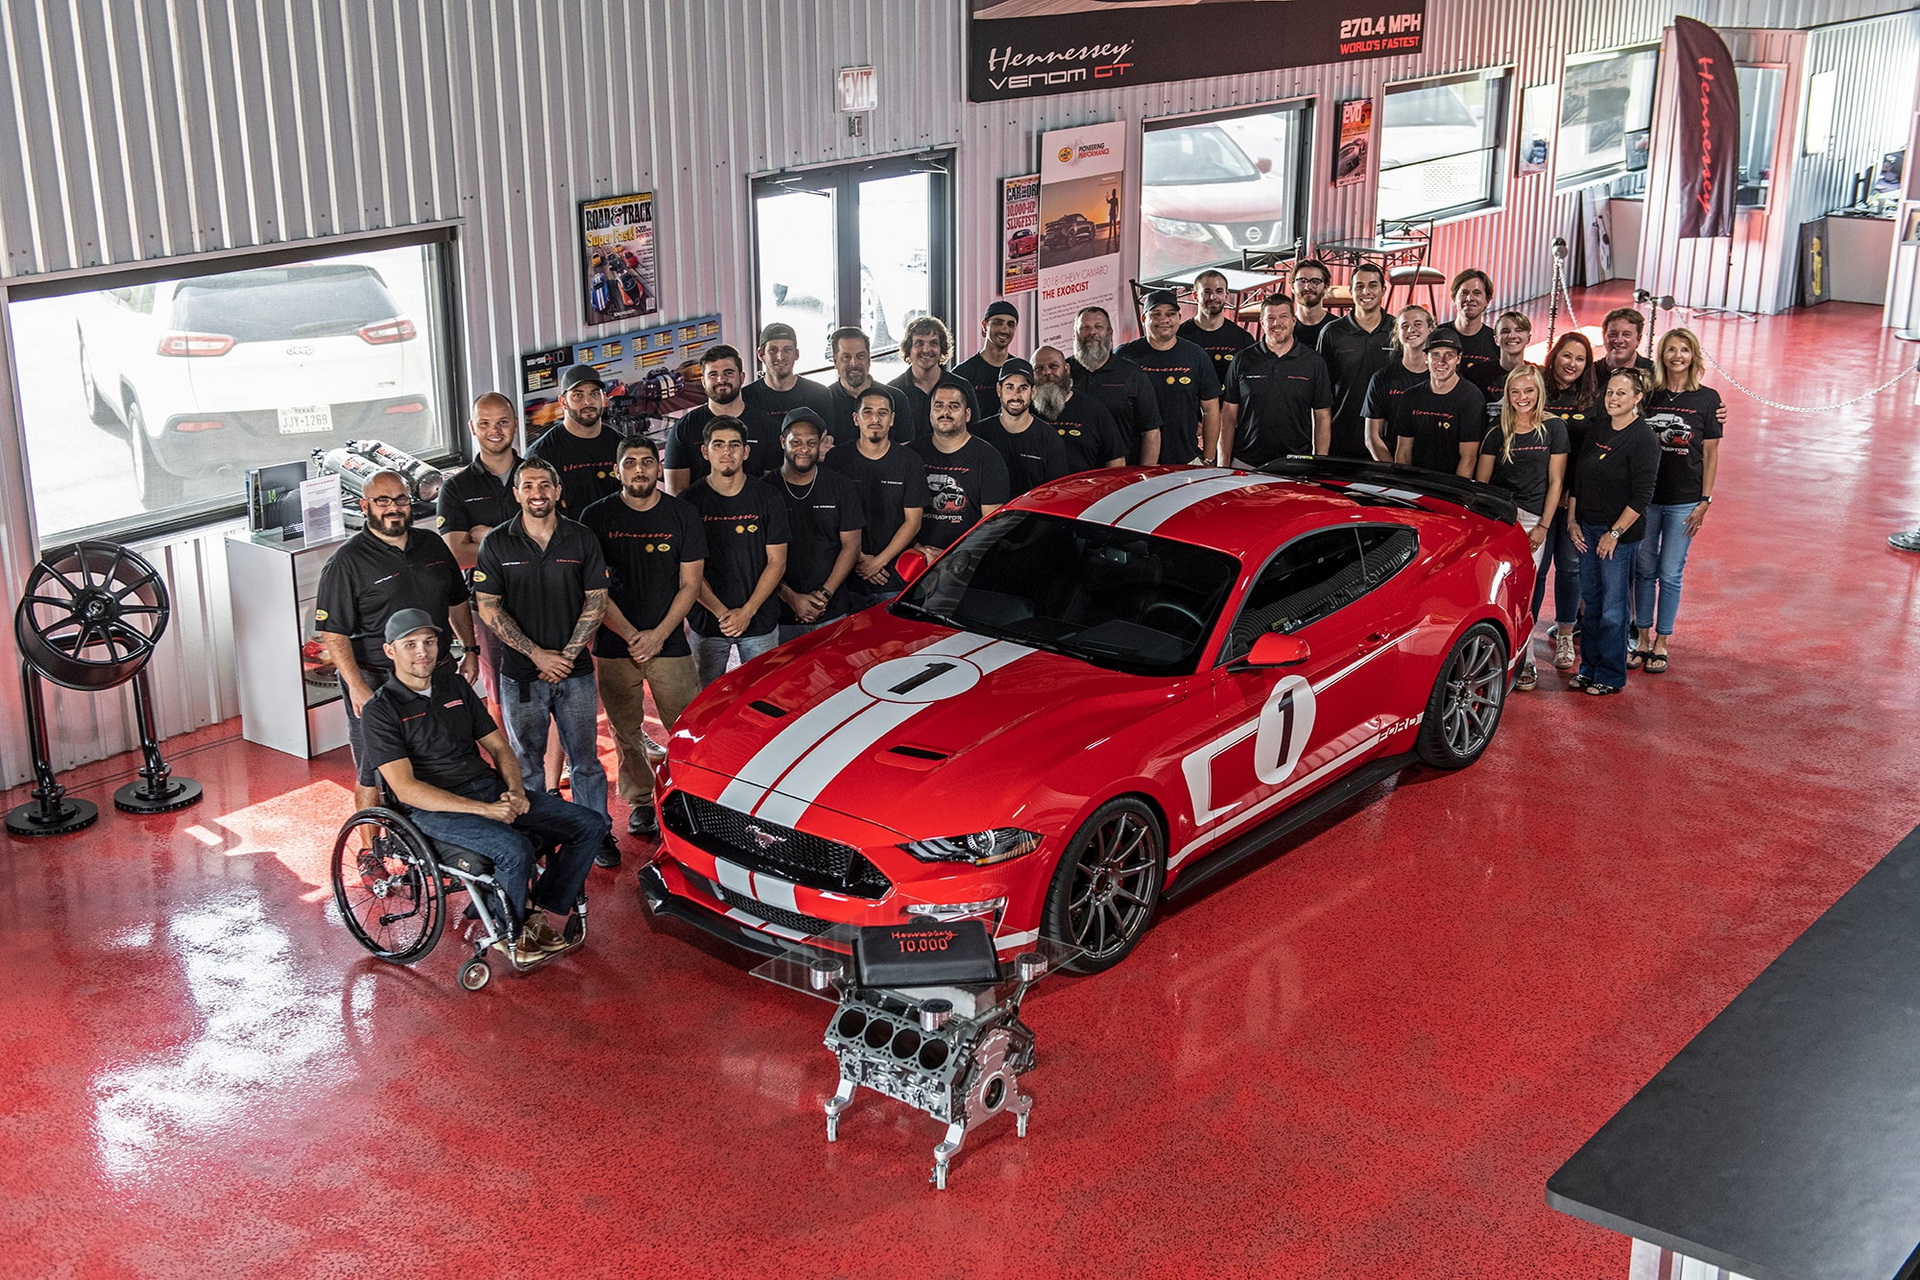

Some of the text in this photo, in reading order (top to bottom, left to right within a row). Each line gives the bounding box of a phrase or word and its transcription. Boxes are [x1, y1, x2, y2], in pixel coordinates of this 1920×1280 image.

[1340, 13, 1422, 39] 270.4 MPH
[988, 42, 1133, 72] Hennessey
[1340, 36, 1420, 55] WORLD'S FASTEST
[1093, 62, 1132, 79] GT
[841, 71, 872, 108] EXIT
[1342, 105, 1363, 124] evo
[1698, 56, 1714, 214] Hennessey
[1006, 186, 1021, 201] CAR
[1026, 183, 1040, 198] DRI
[585, 207, 611, 231] ROAD
[621, 201, 652, 226] TRACK
[586, 231, 612, 248] Super
[612, 225, 636, 246] Fast!
[1042, 275, 1059, 289] 2018
[1059, 271, 1081, 285] CHEVY
[1081, 264, 1109, 280] CAMARO
[1042, 281, 1090, 300] THE EXORCIST
[286, 345, 314, 355] Jeep
[887, 661, 958, 696] 1
[1276, 688, 1294, 769] 1
[1378, 715, 1418, 742] FORD
[891, 930, 959, 941] Hennessey
[899, 939, 949, 954] 10,000
